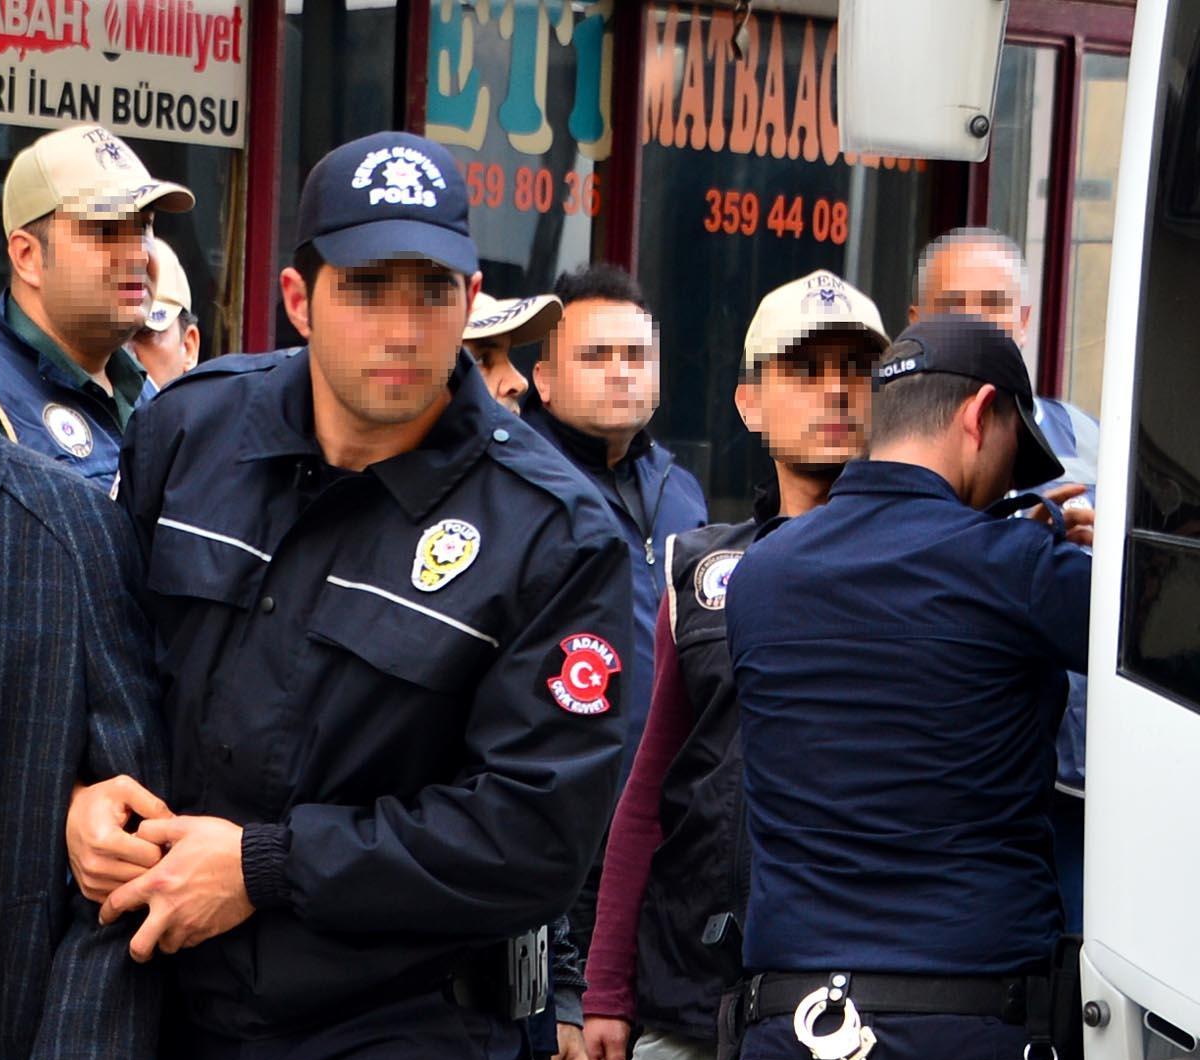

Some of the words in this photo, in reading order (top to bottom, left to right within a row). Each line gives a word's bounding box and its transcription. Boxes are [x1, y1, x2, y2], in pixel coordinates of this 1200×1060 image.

[124, 0, 243, 73] Milliyet
[28, 68, 100, 122] İLAN
[112, 81, 239, 137] BÜROSU
[642, 2, 927, 172] MATBAAC
[457, 160, 505, 209] 59
[514, 165, 554, 213] 80
[563, 170, 601, 217] 36
[704, 189, 760, 236] 359
[767, 194, 804, 239] 44
[812, 198, 849, 245] 08
[572, 637, 614, 666] ADANA
